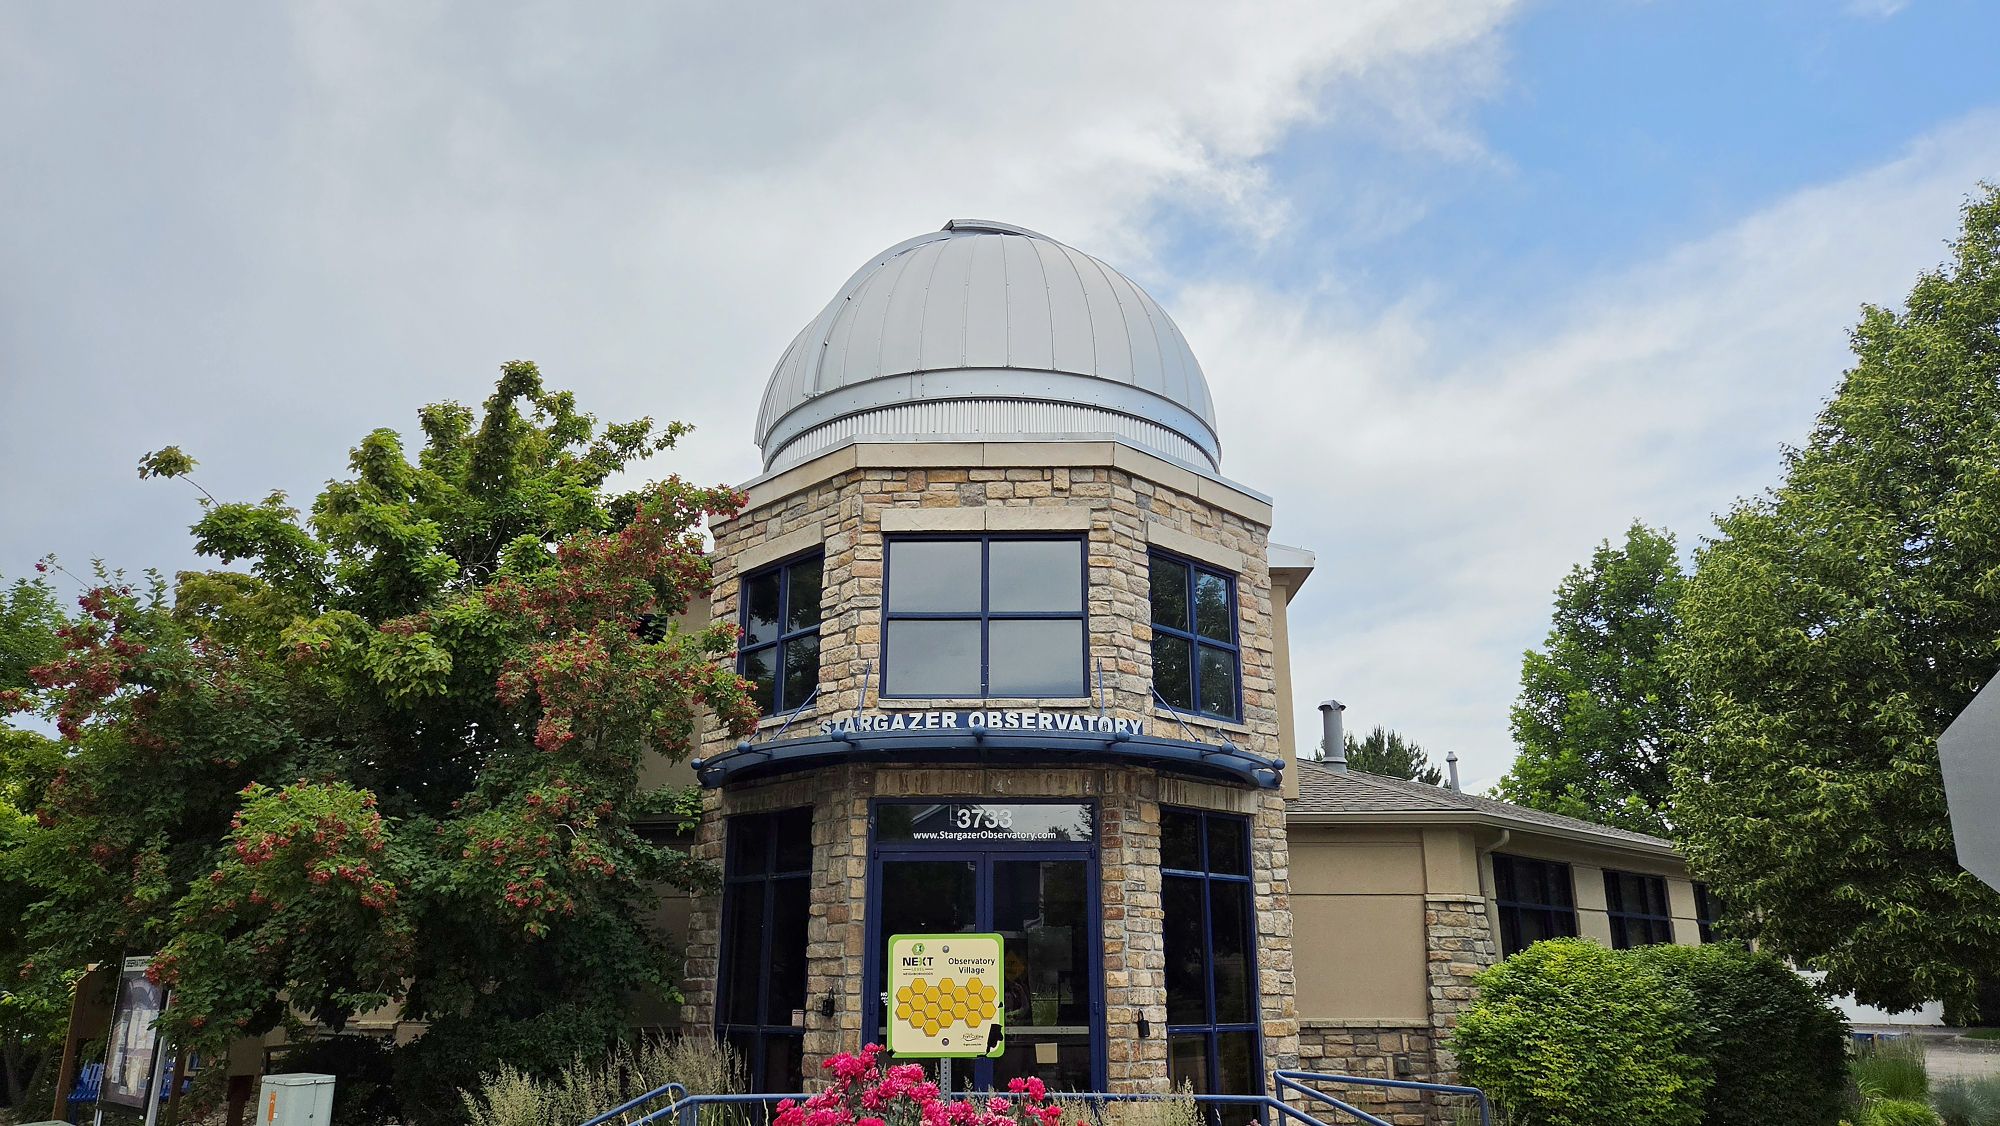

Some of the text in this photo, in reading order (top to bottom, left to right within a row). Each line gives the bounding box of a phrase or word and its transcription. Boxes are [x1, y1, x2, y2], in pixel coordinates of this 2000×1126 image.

[820, 711, 1142, 736] STARGAZER OBSERVATORY
[956, 808, 1013, 829] 3733
[913, 830, 1057, 841] www.StargazerObservatory.com
[902, 957, 934, 966] NEXT
[948, 957, 996, 966] Observatory
[958, 966, 985, 975] Village
